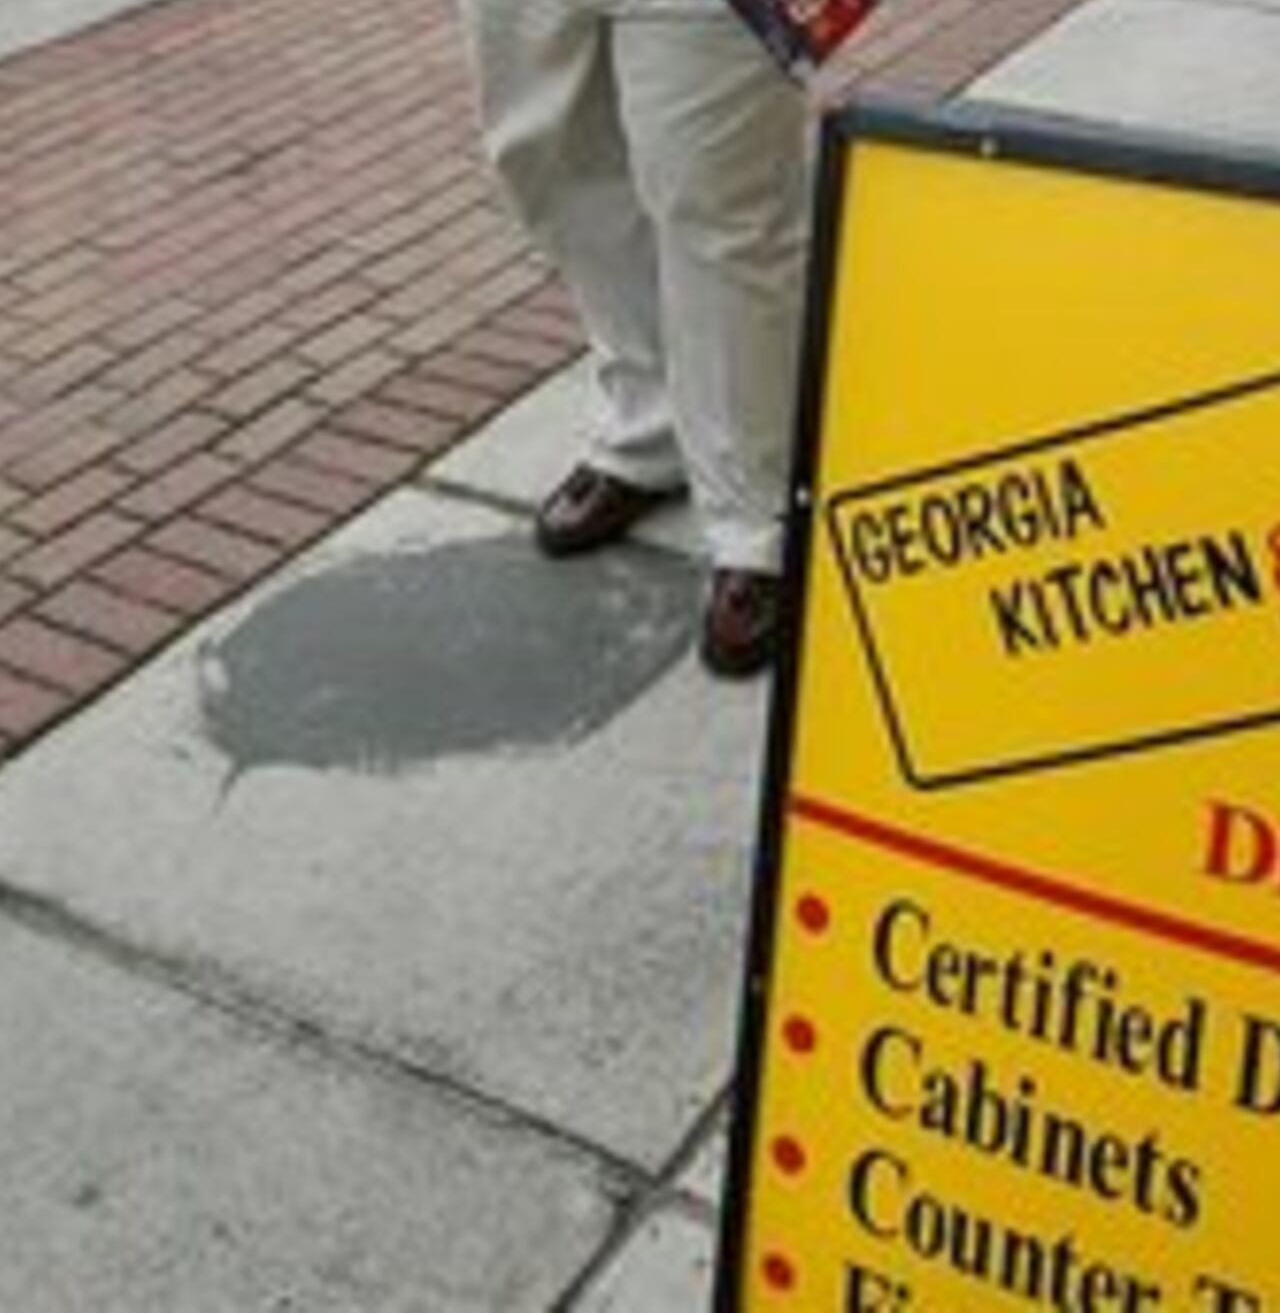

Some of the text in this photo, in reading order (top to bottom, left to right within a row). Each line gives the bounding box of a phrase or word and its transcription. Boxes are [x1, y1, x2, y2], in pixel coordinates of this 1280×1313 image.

[850, 459, 1105, 584] GEORGIA
[990, 531, 1263, 656] KITCHEN
[871, 900, 1205, 1092] Certified
[860, 1027, 1201, 1227] Cabinets
[847, 1149, 1160, 1313] Counter
